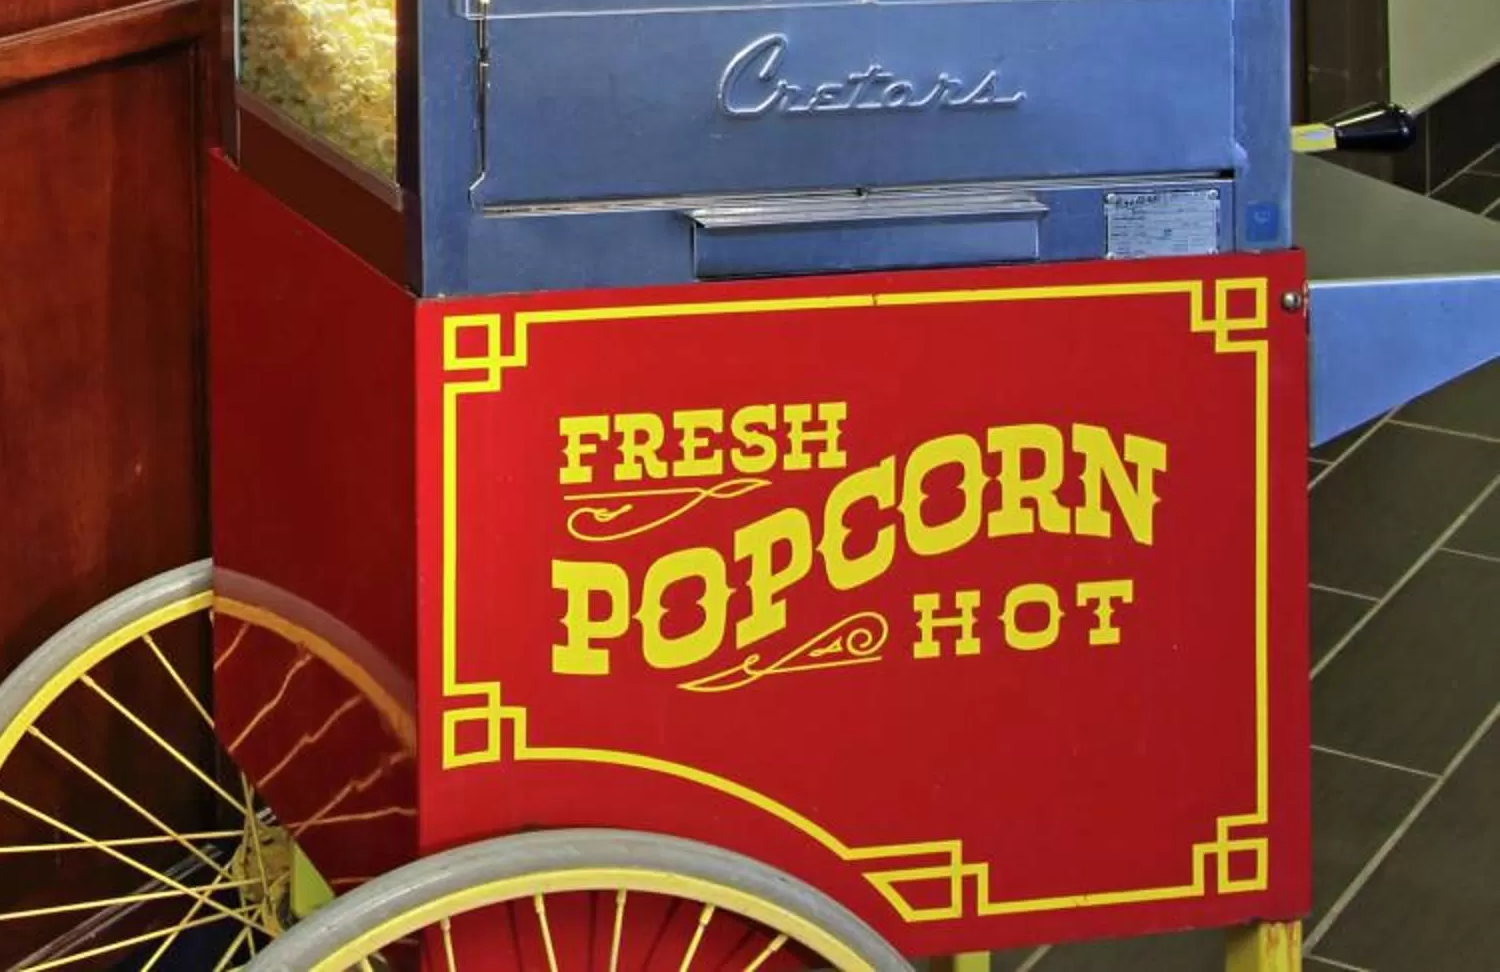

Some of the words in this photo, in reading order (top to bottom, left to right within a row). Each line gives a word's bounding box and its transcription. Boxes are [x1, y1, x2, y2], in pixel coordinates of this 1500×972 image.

[717, 32, 1027, 115] Cretors
[559, 401, 847, 485] FRESH
[551, 422, 1168, 676] POPCORN
[912, 579, 1134, 659] HOT
